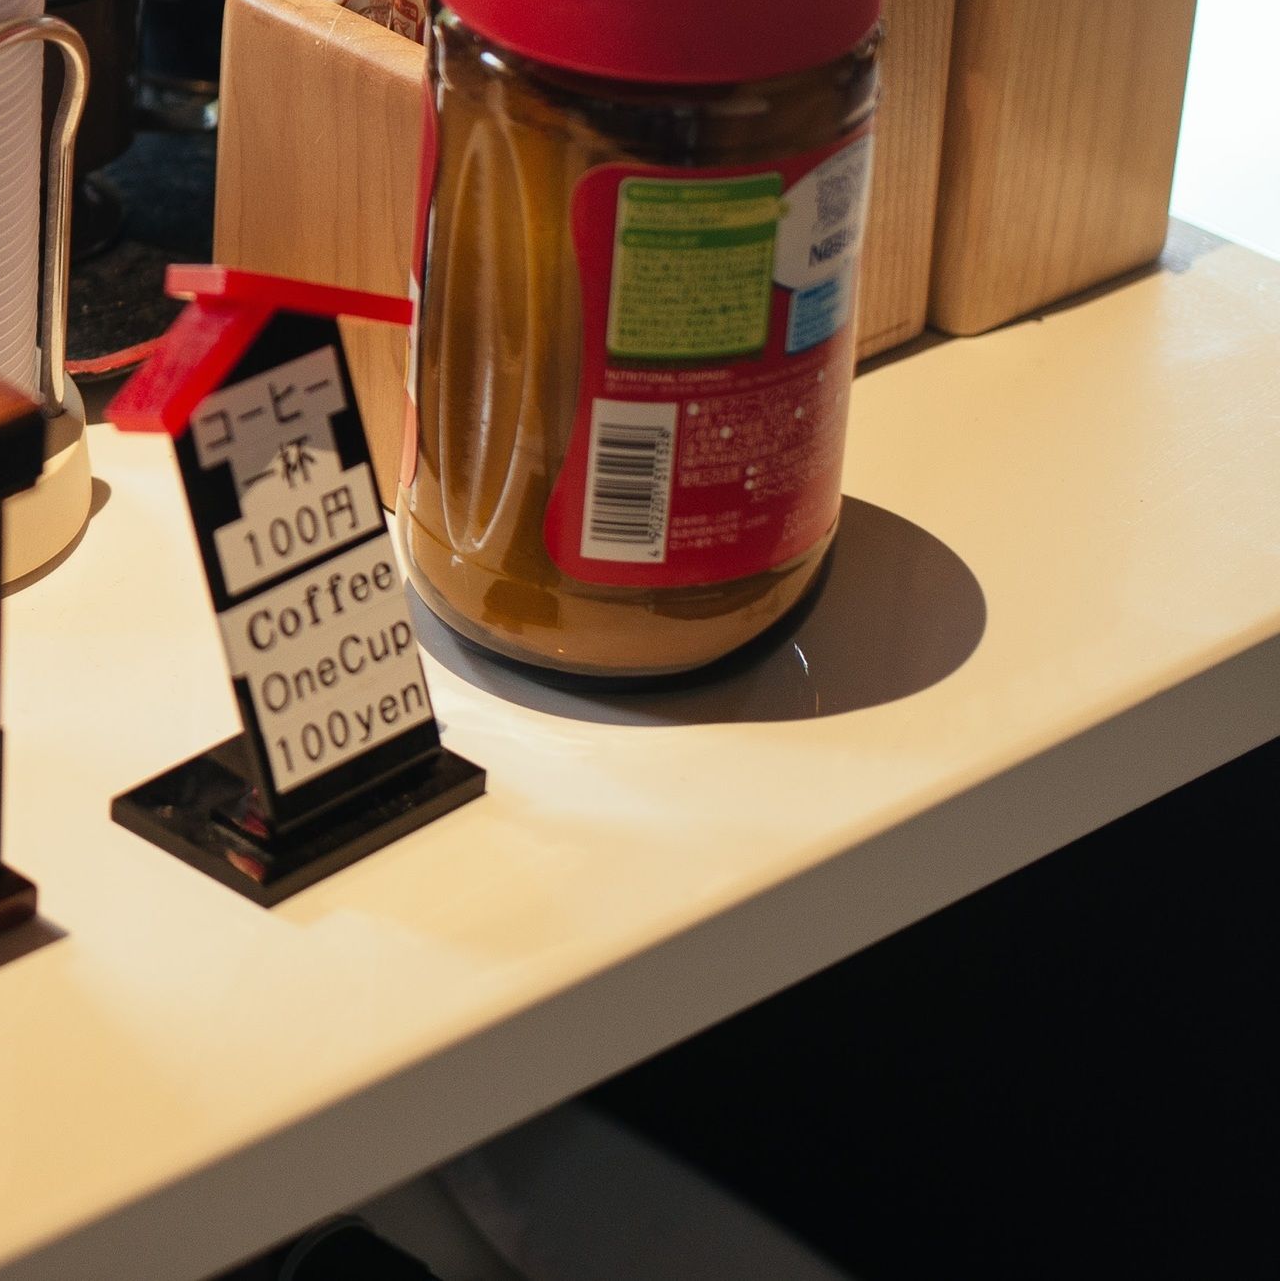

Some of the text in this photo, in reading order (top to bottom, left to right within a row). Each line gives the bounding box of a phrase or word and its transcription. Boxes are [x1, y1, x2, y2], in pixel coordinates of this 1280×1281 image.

[200, 378, 330, 450] コーヒー
[241, 434, 316, 489] 一杯
[244, 484, 359, 567] 100円
[245, 559, 394, 652] Coffee
[261, 620, 413, 714] OneCup
[275, 681, 426, 775] 100yen
